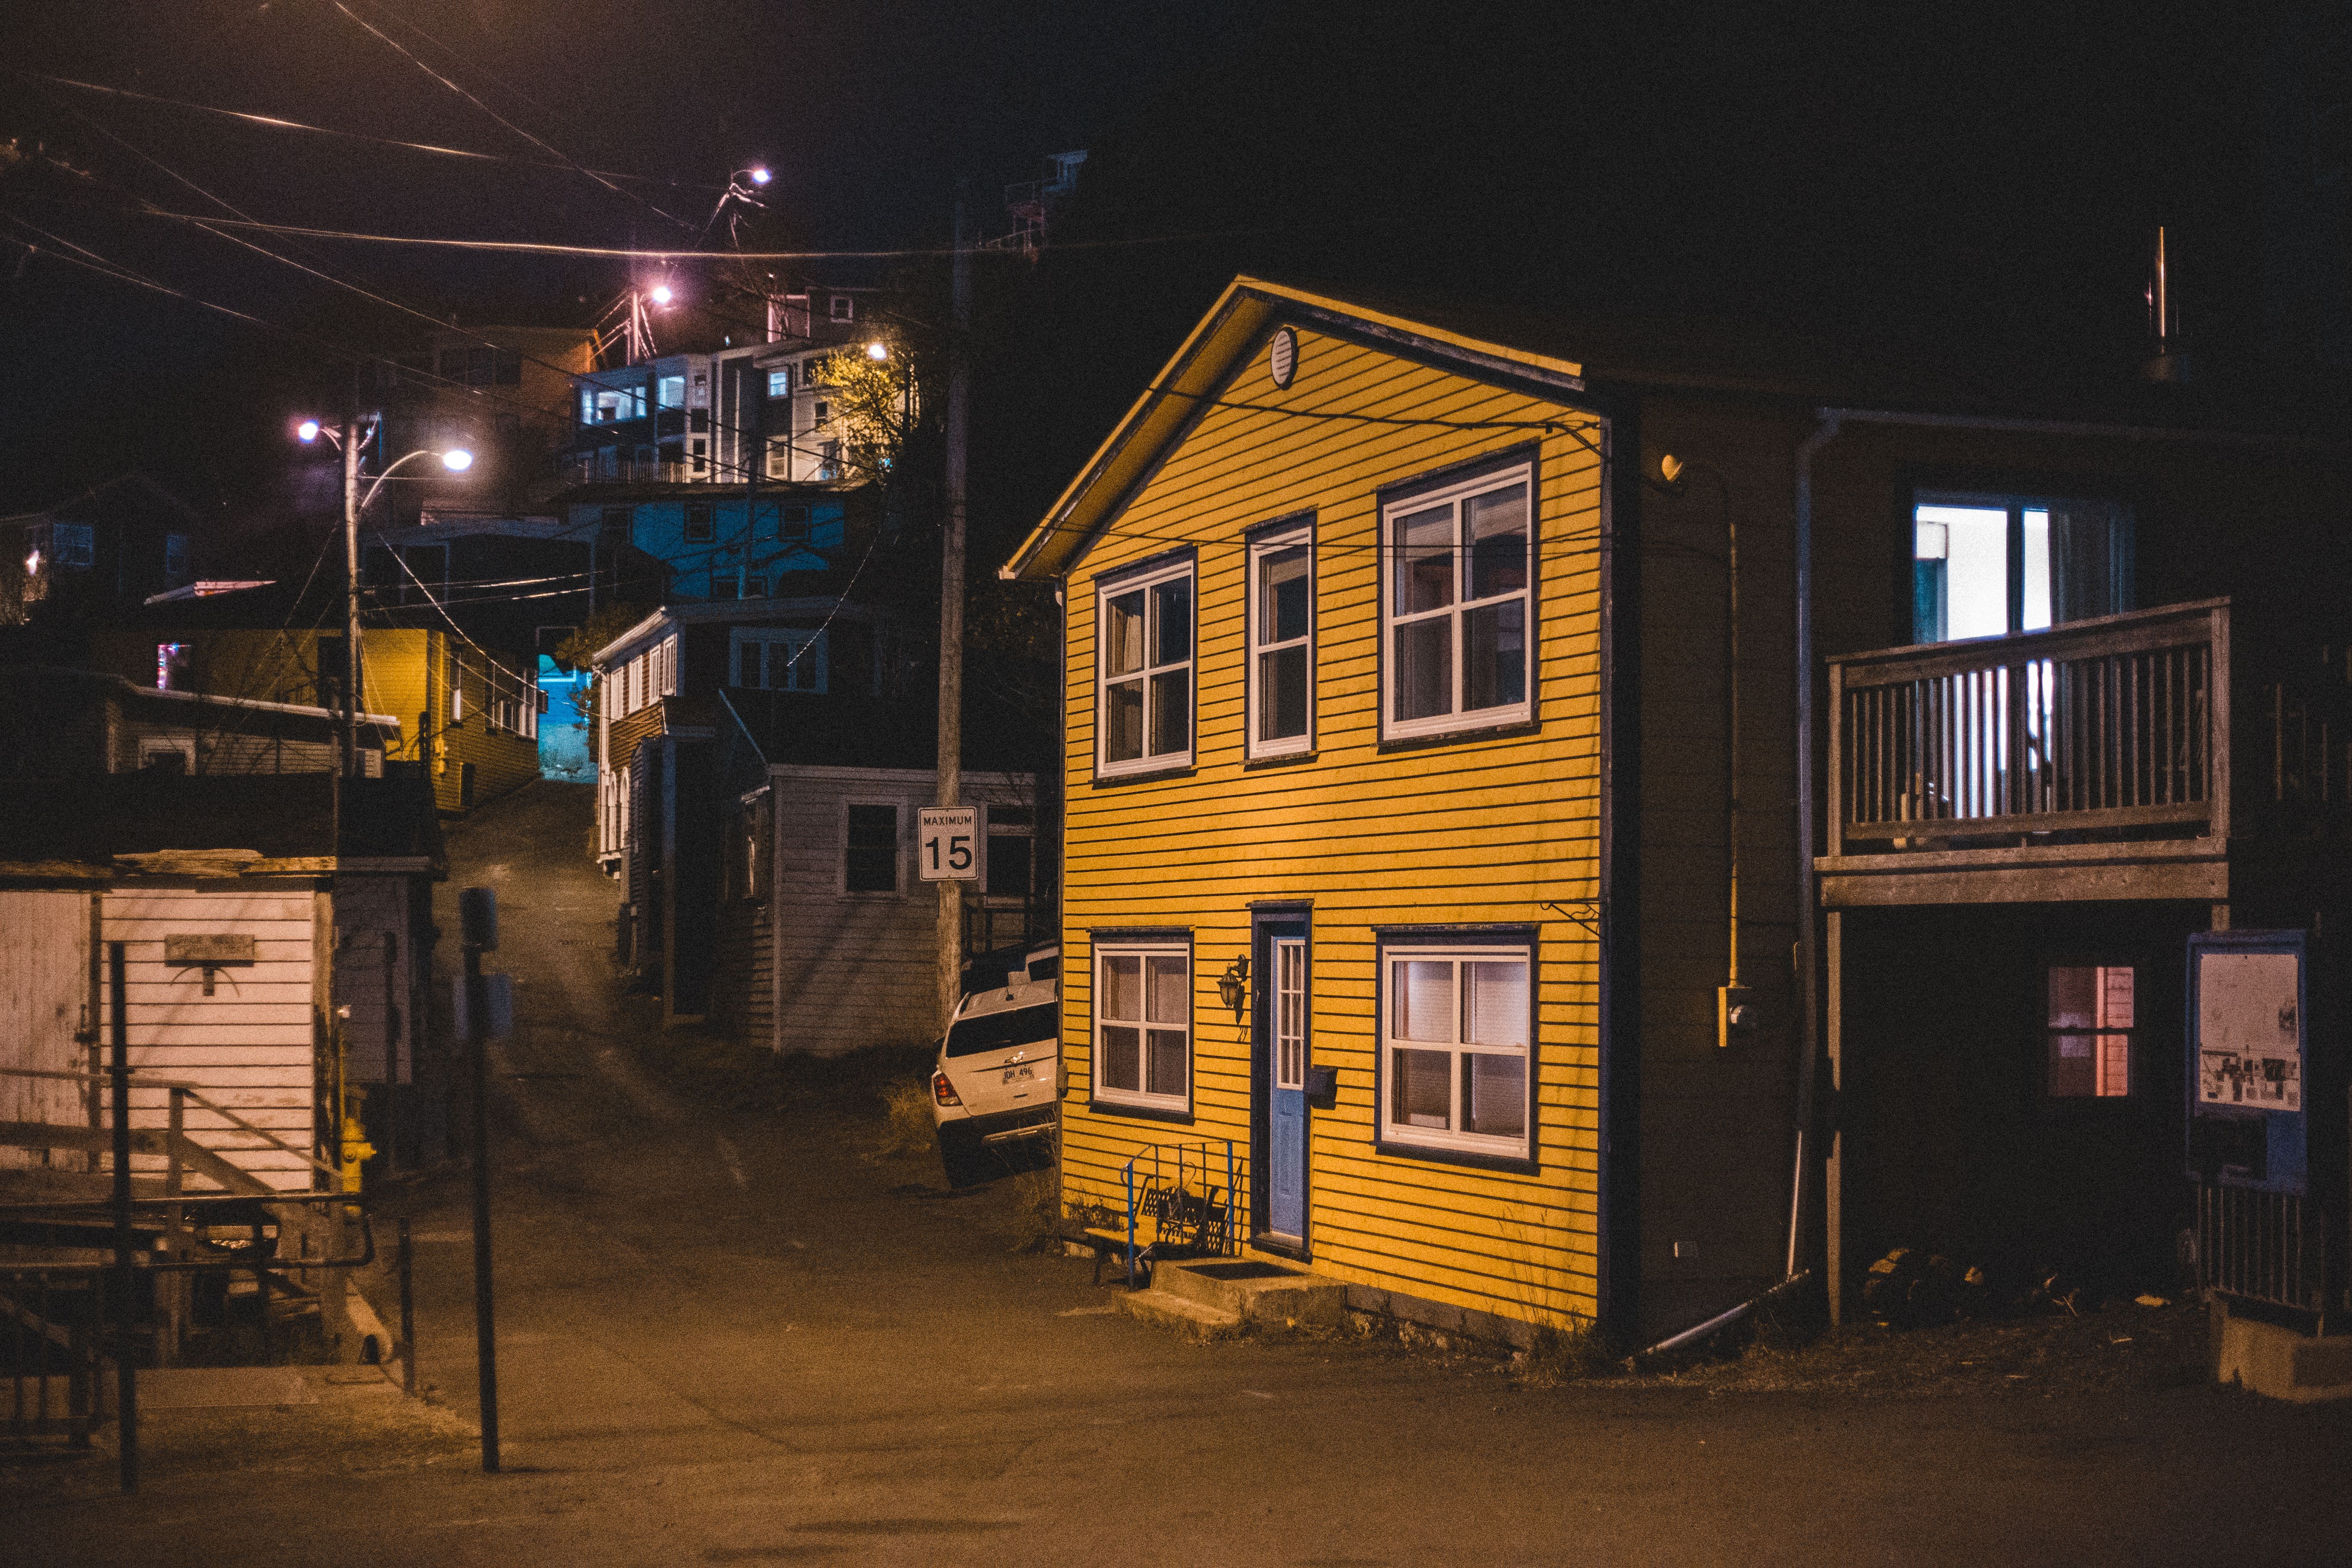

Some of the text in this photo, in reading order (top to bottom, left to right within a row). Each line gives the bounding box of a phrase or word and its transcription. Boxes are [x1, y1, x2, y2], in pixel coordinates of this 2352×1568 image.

[923, 816, 972, 826] MAXIMUM
[925, 836, 972, 870] 15
[1019, 1066, 1032, 1077] 496
